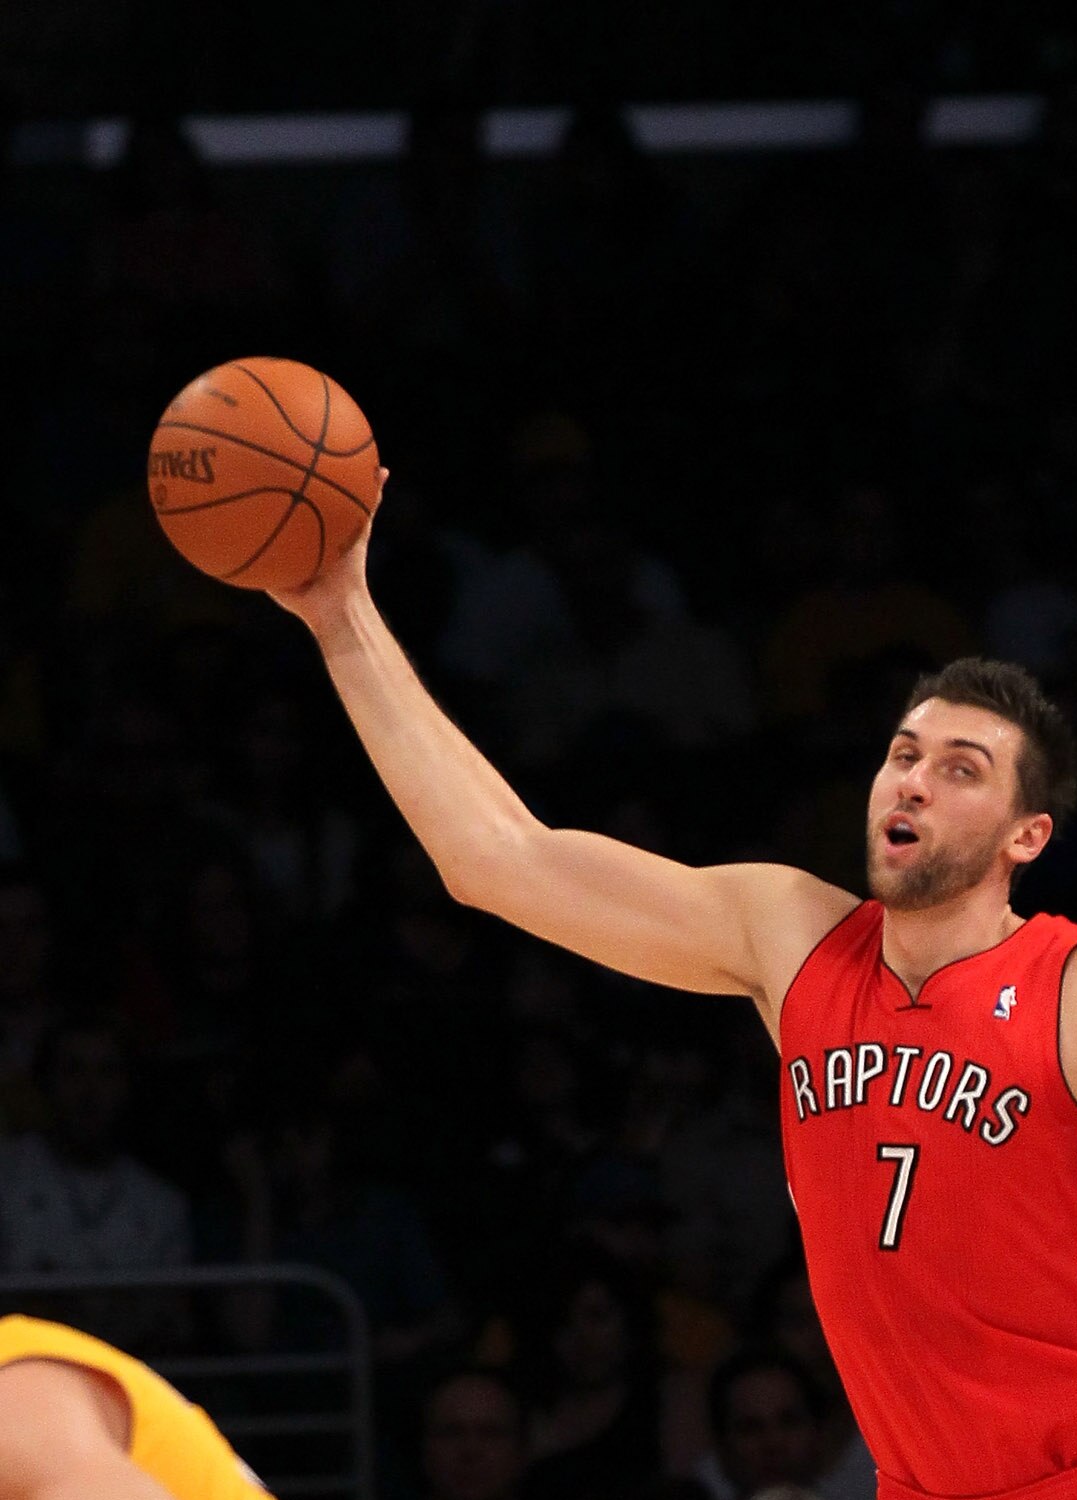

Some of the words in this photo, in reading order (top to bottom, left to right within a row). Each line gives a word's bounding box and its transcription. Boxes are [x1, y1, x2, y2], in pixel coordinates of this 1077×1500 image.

[150, 446, 216, 484] SPAL
[788, 1041, 1032, 1147] RAPTORS
[876, 1142, 921, 1252] 7
